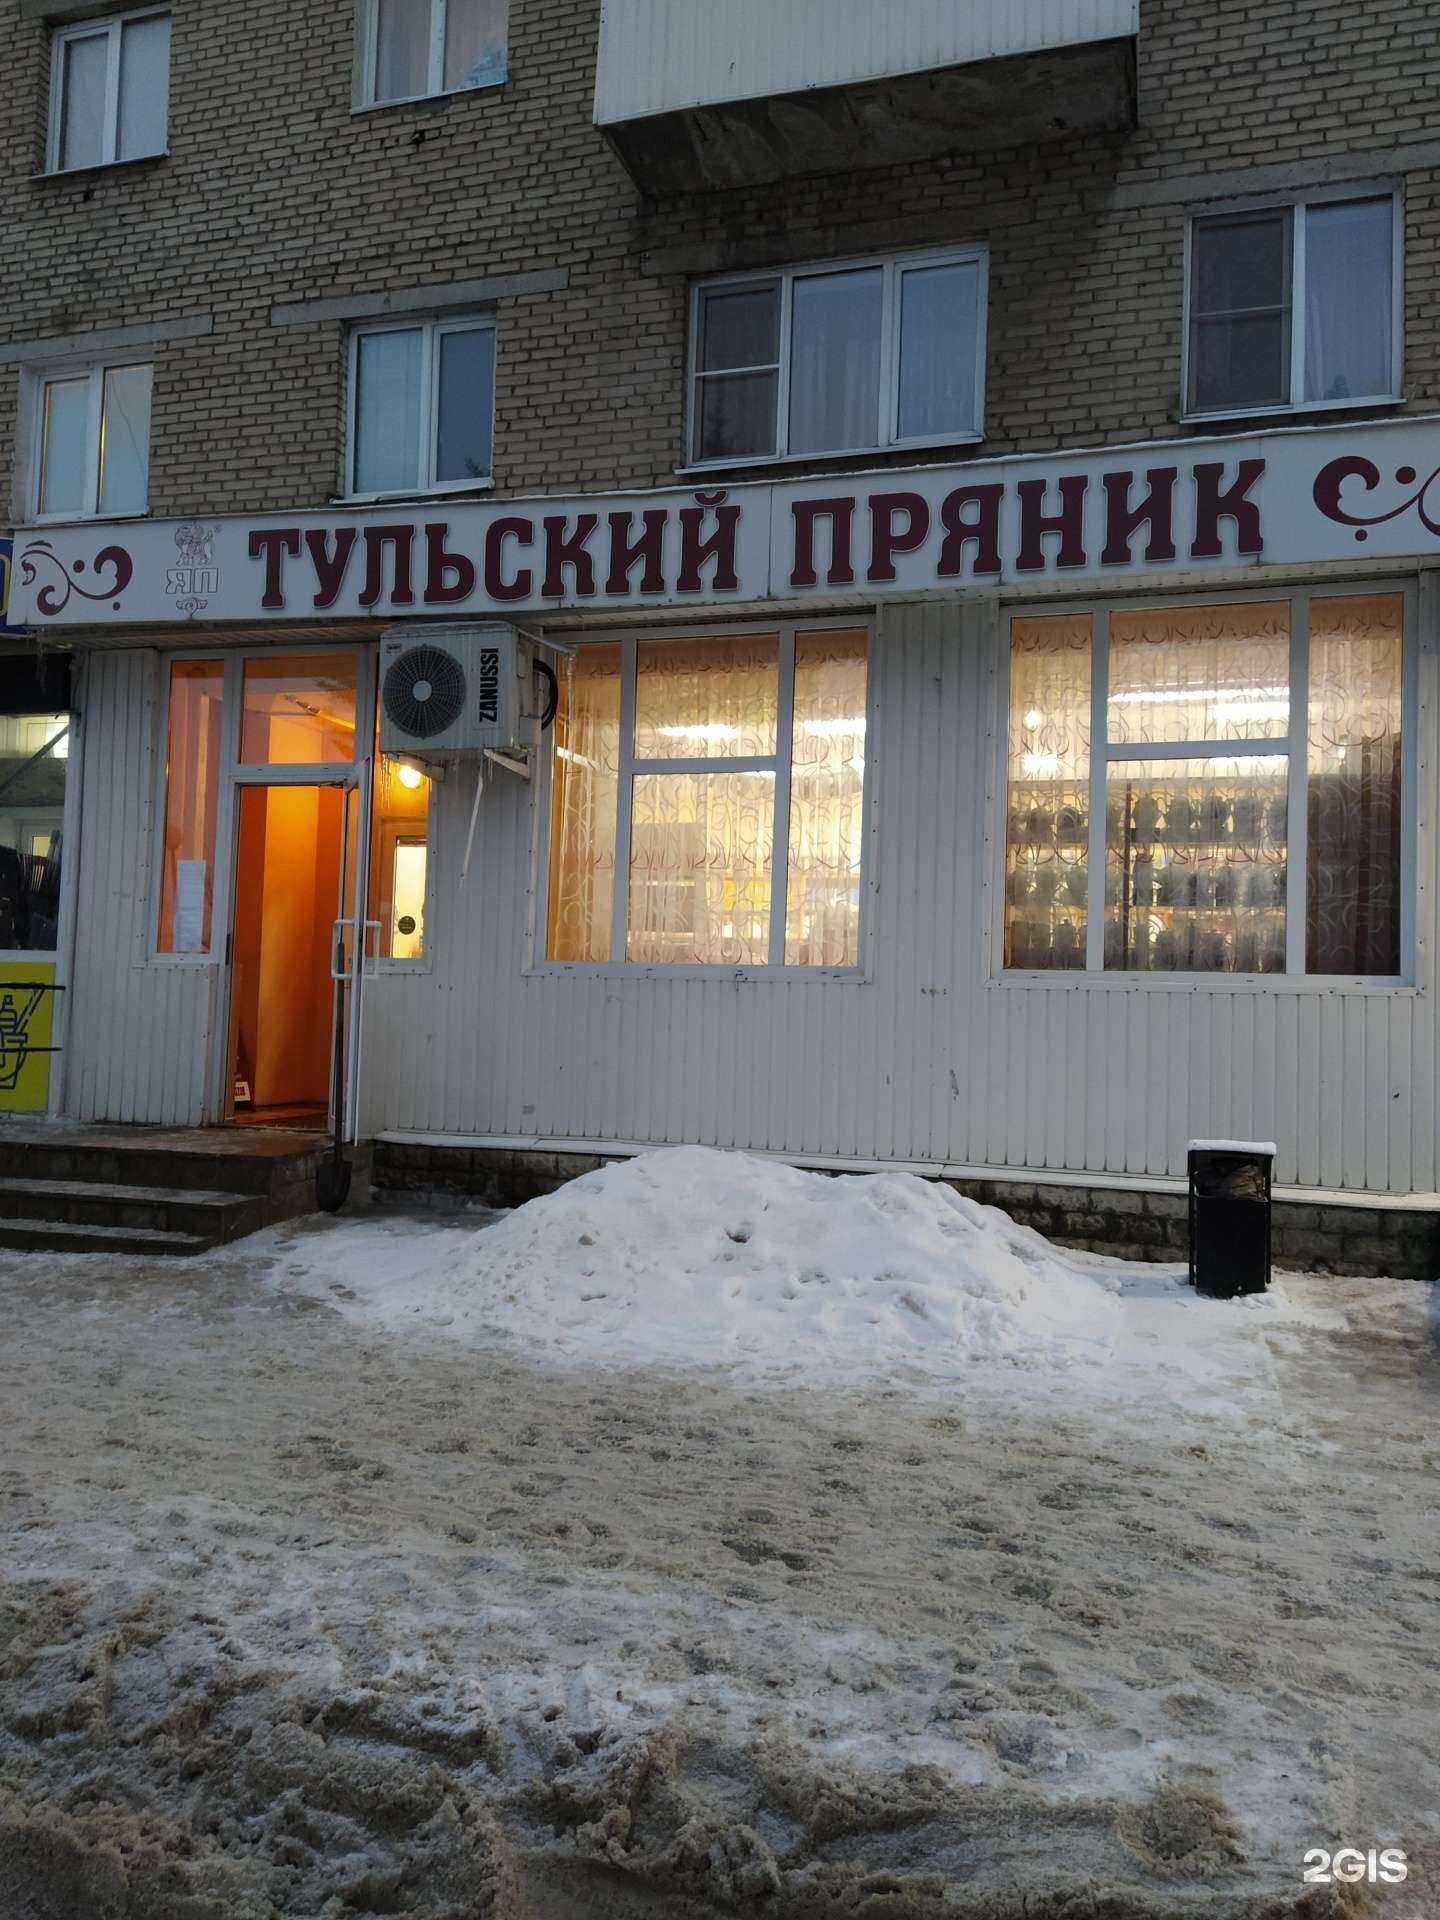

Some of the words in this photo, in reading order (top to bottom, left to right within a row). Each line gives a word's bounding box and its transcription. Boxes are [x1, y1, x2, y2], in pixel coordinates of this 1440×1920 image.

[248, 490, 742, 608] ТУЛЬСКИЙ
[790, 458, 1266, 587] ПРЯНИК
[479, 648, 499, 723] ZANUSSI
